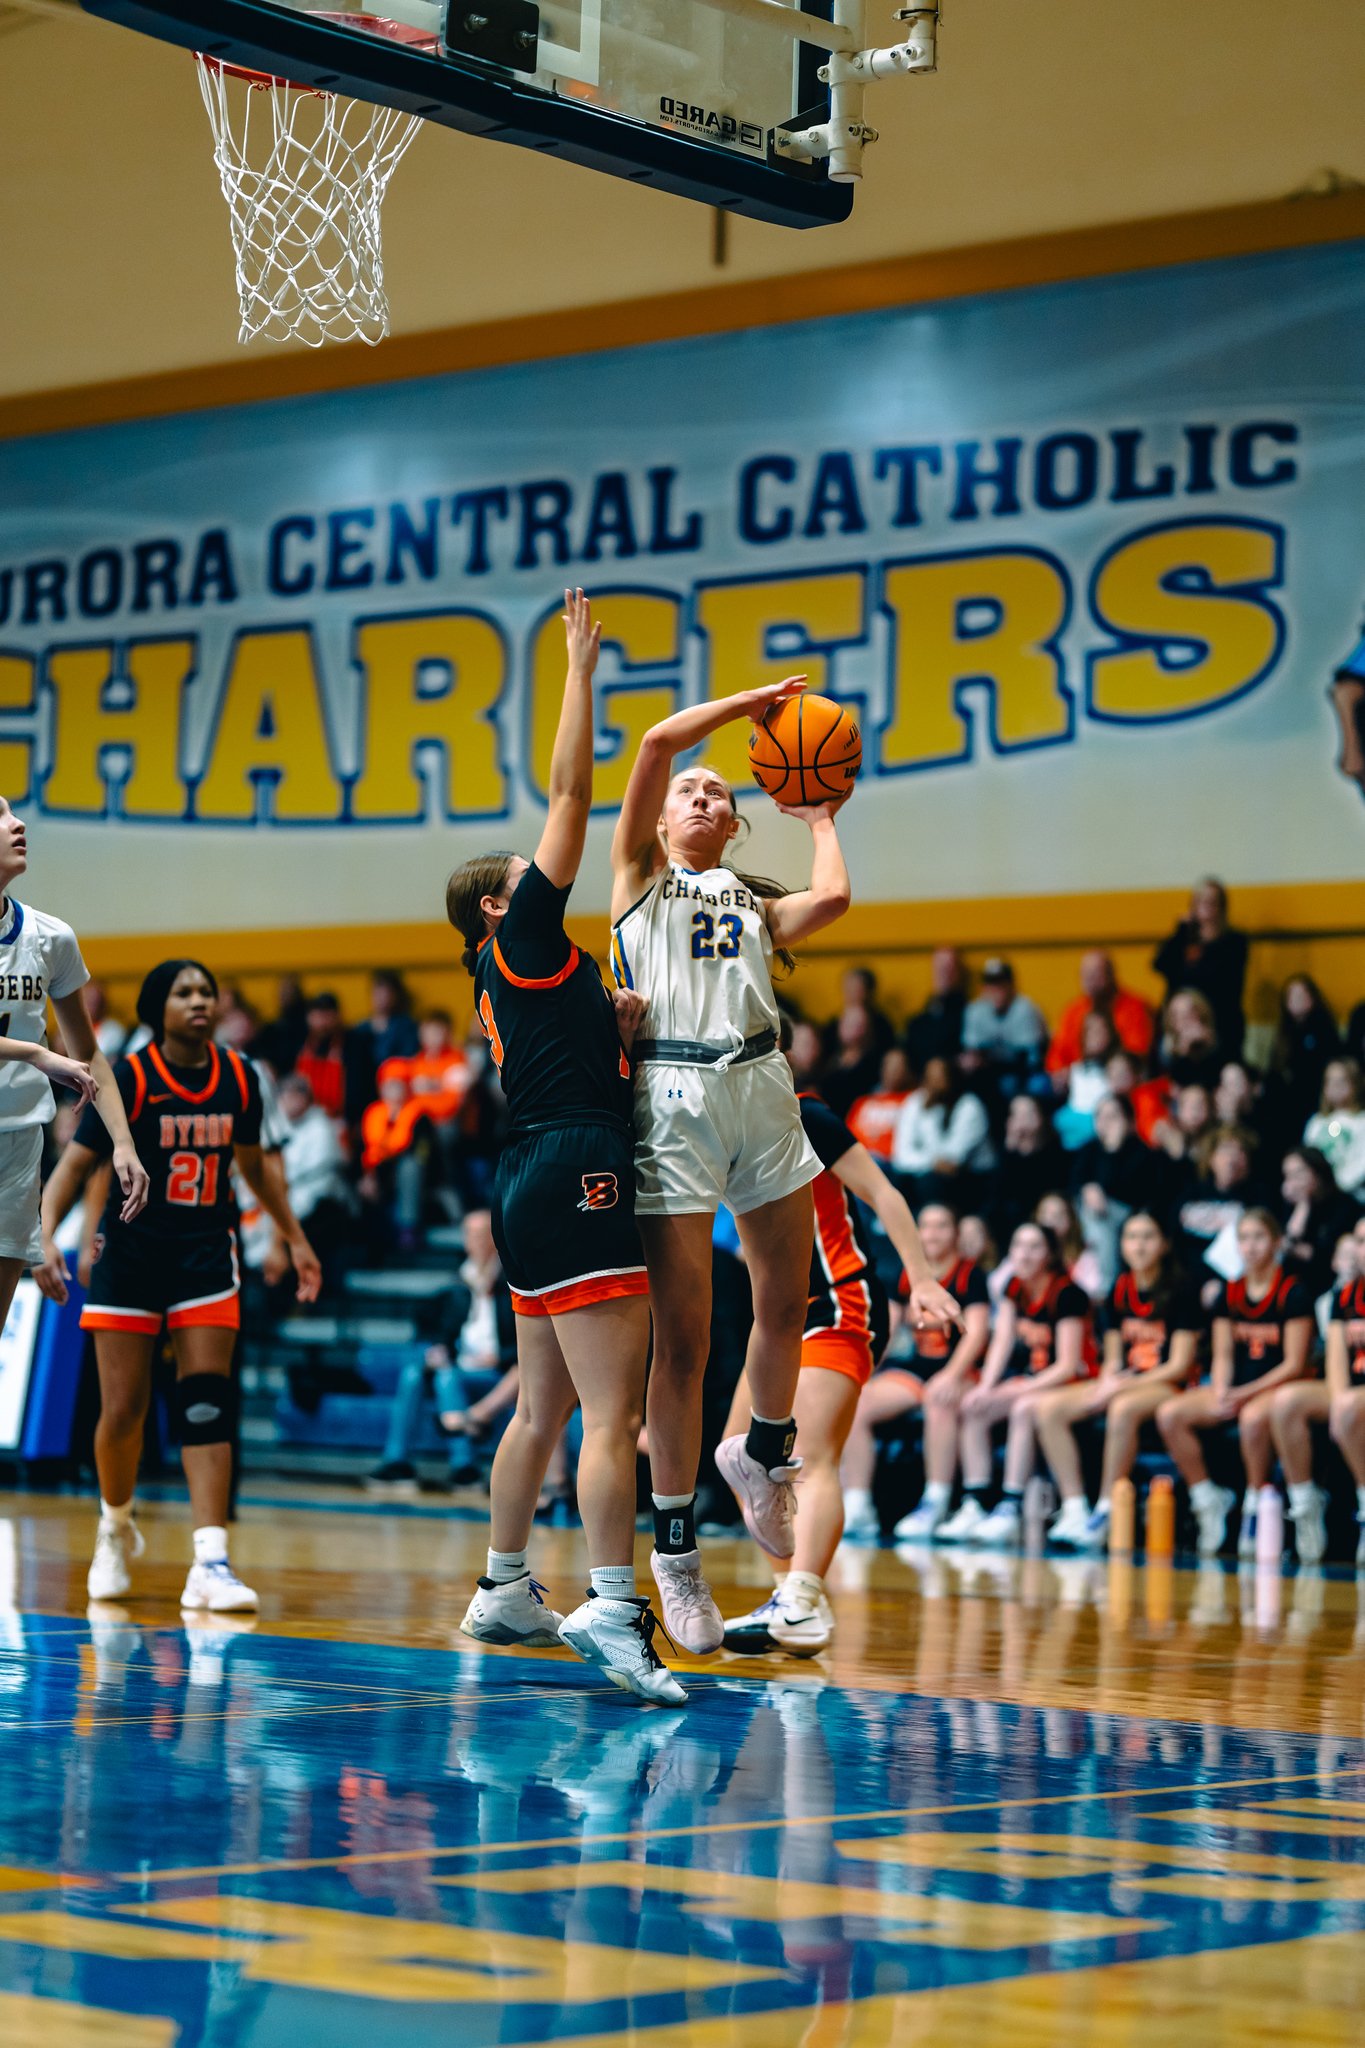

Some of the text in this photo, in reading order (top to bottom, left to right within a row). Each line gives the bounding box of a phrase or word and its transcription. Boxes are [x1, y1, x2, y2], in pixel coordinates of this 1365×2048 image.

[267, 466, 704, 596] CENTRAL
[738, 421, 1299, 545] CATHOLIC
[0, 513, 1287, 828] HARGERS
[691, 911, 744, 960] 23
[160, 1113, 234, 1147] BYRON
[166, 1151, 220, 1207] 21
